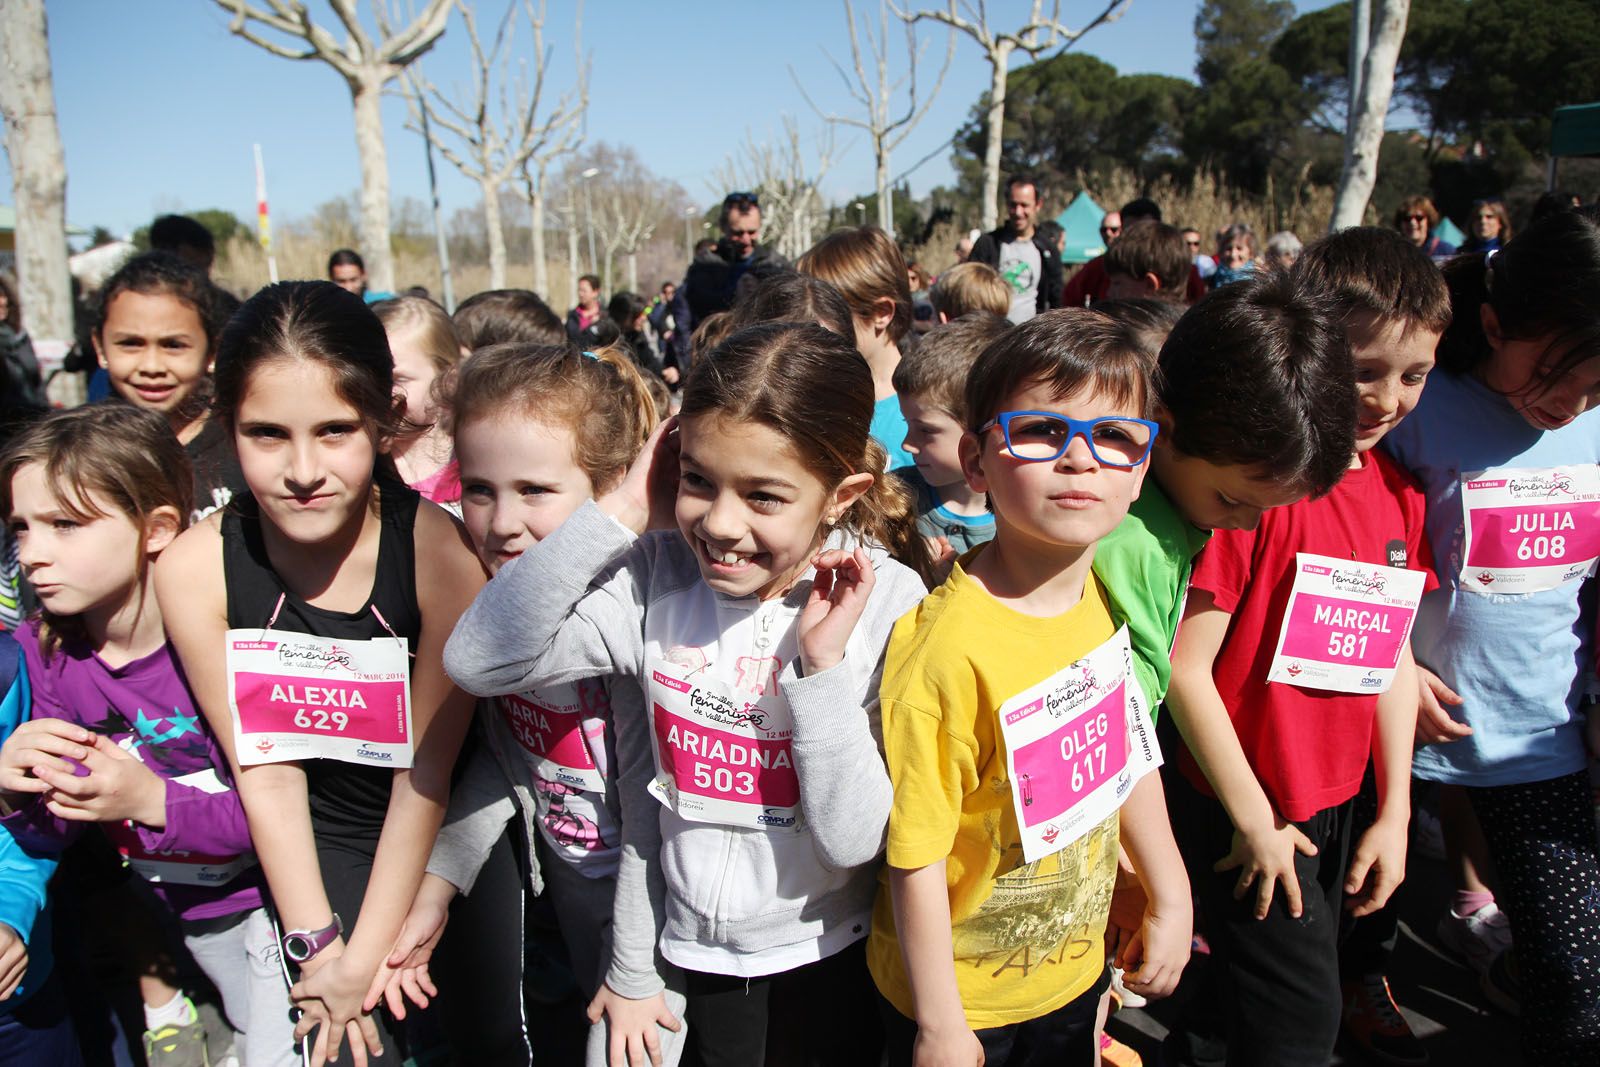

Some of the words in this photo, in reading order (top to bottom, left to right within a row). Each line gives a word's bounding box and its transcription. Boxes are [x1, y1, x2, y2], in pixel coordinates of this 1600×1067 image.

[1508, 479, 1570, 495] femenines
[1509, 511, 1575, 534] JULIA
[1516, 536, 1566, 561] 608
[1332, 569, 1386, 591] femenines
[1313, 604, 1391, 635] MARÇAL
[278, 643, 350, 666] femenines
[1327, 632, 1368, 659] 581
[386, 672, 405, 680] 2016
[270, 684, 367, 709] ALEXIA
[690, 688, 765, 726] femenines
[293, 708, 349, 731] 629
[501, 695, 552, 734] MARIA
[694, 707, 703, 716] de
[512, 719, 546, 753] 561
[667, 724, 792, 769] ARIADNA
[766, 731, 776, 739] 12
[1060, 713, 1108, 761] OLEG
[694, 762, 754, 795] 503
[1070, 742, 1108, 793] 617
